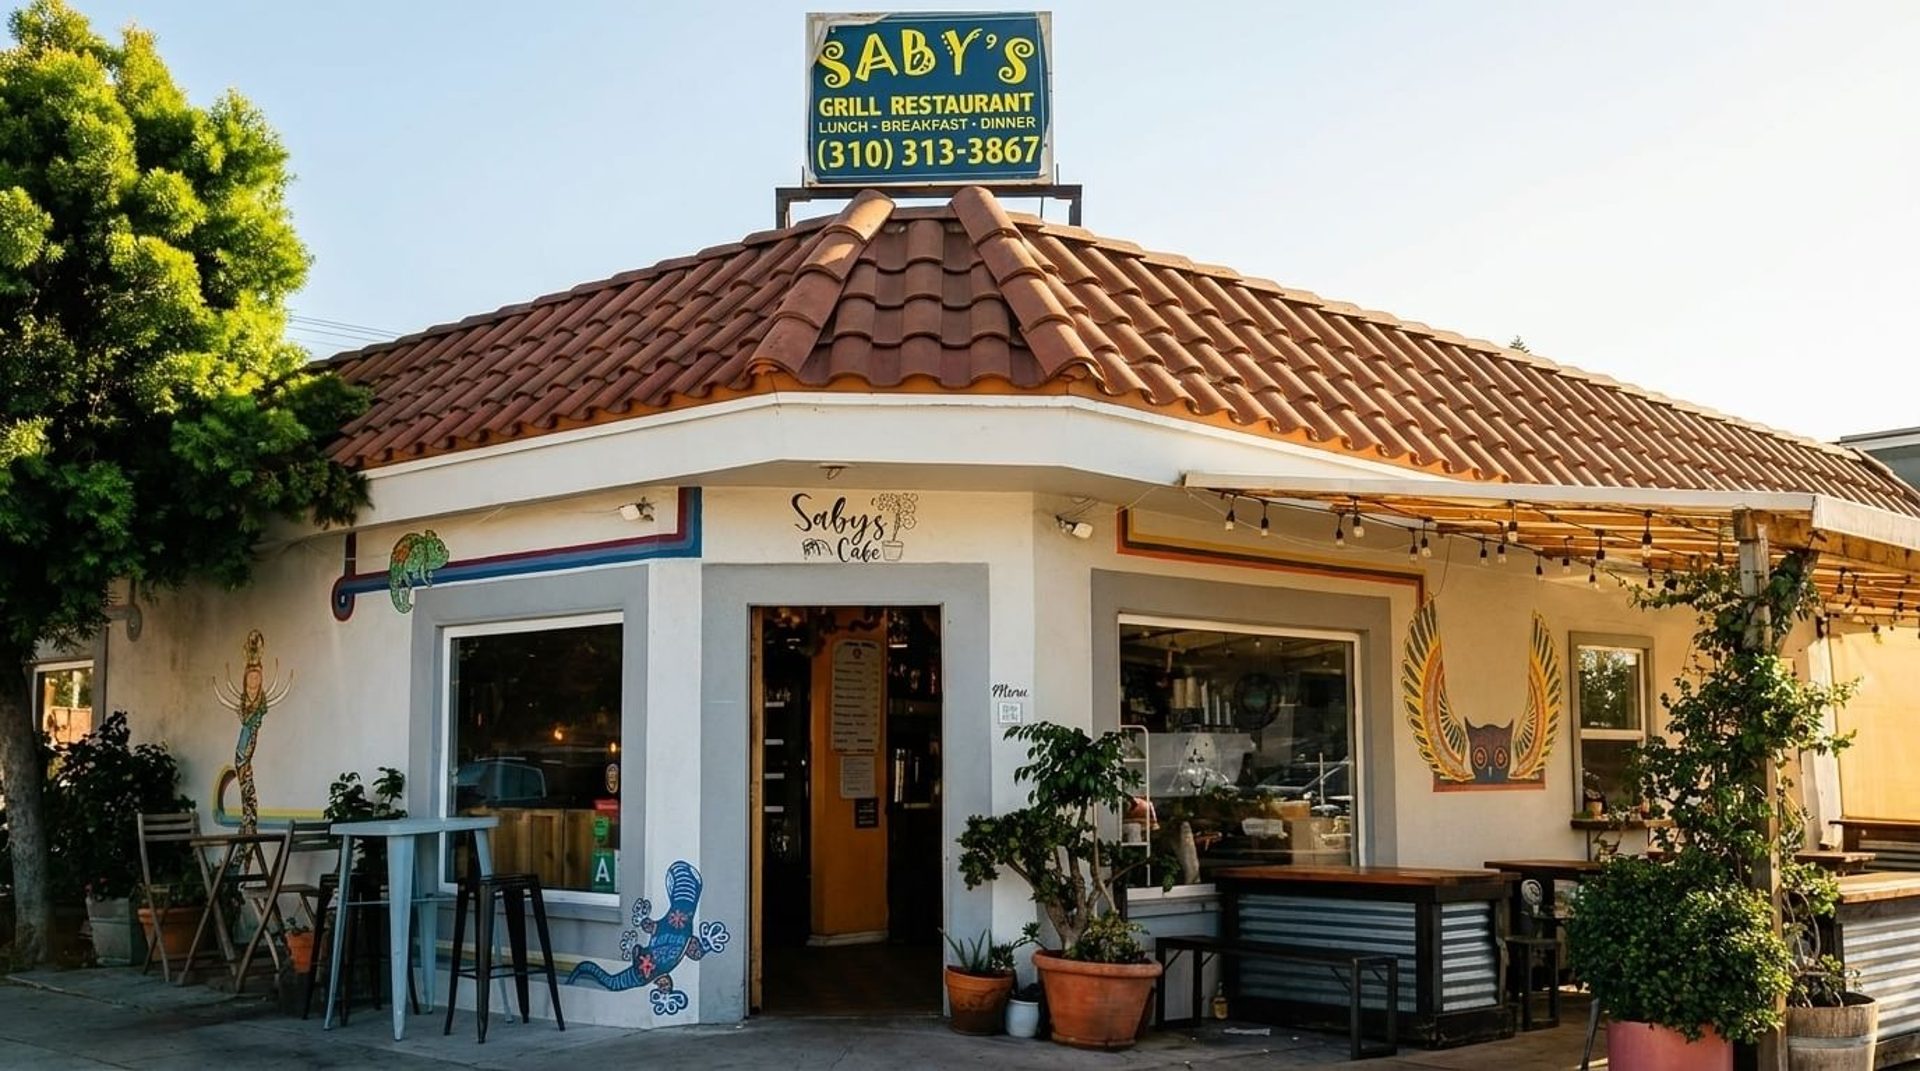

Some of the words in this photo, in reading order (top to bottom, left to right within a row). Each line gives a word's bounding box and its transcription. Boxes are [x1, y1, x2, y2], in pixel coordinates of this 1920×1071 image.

[818, 28, 1035, 88] SABY'S
[819, 97, 881, 117] GRILL
[891, 93, 1034, 116] RESTAURANT
[819, 121, 868, 133] LUNCH
[881, 119, 969, 132] BREAKFAST
[981, 117, 1036, 129] DINNER
[818, 139, 894, 170] (310)
[902, 136, 1039, 166] 313-3867
[992, 684, 1028, 698] Menu
[595, 857, 610, 882] A
